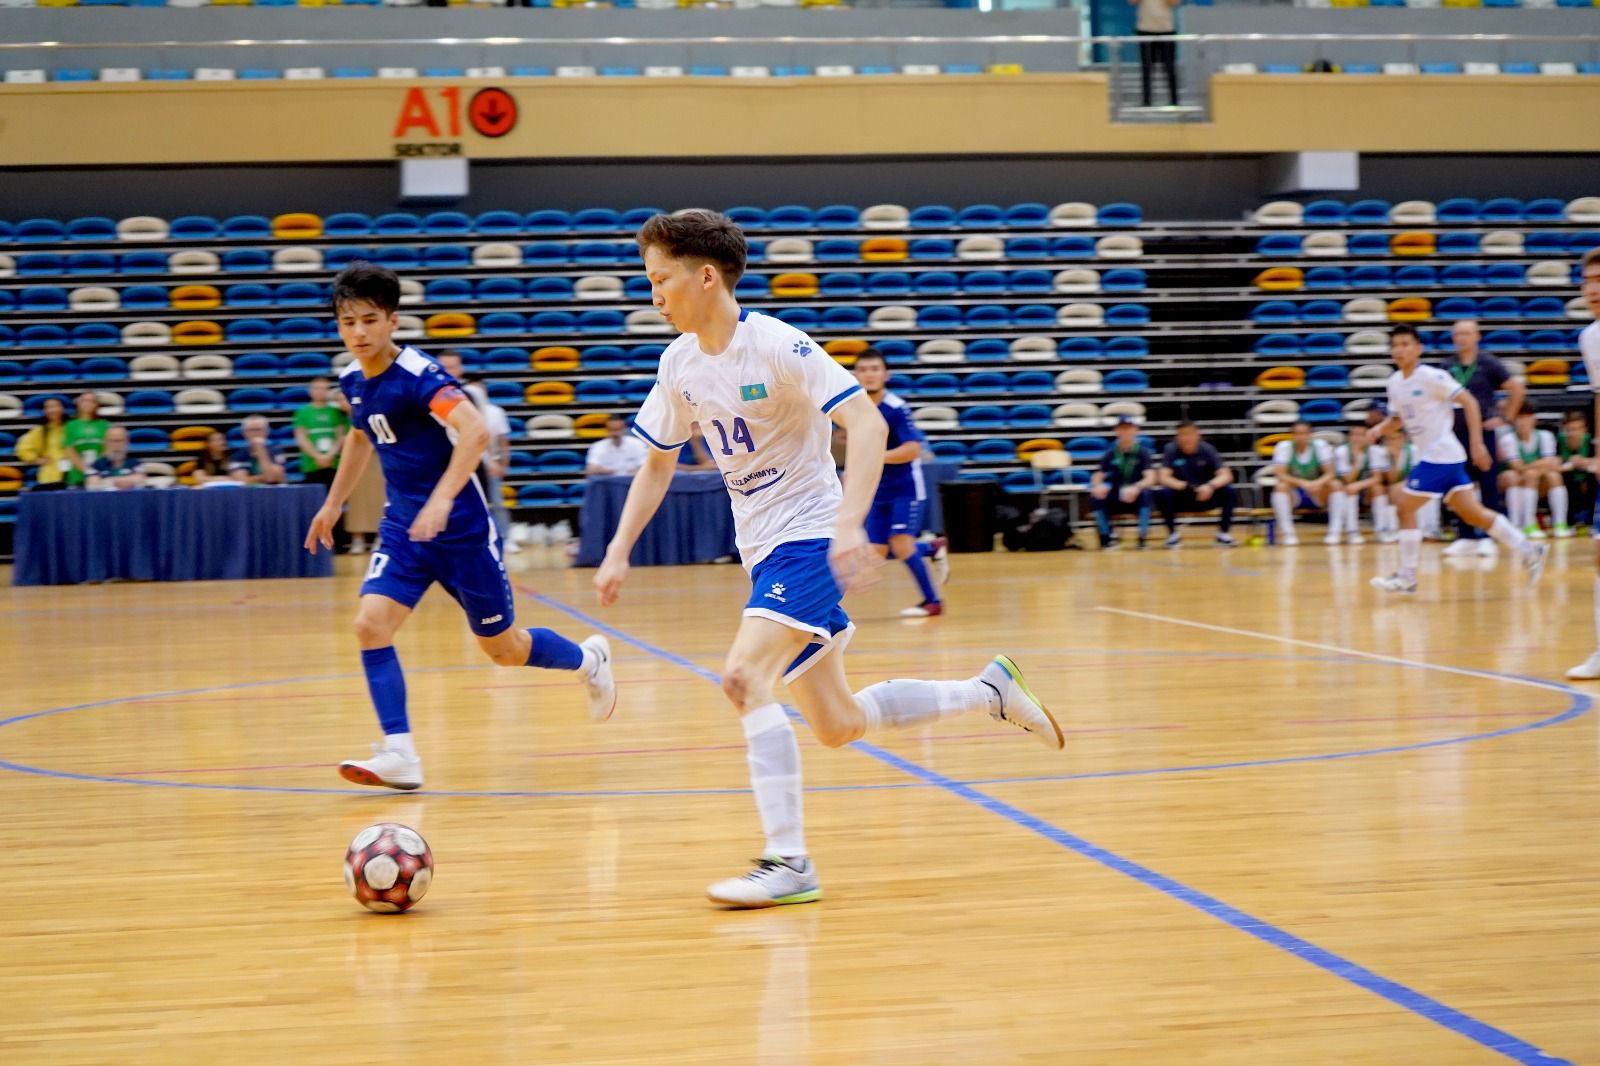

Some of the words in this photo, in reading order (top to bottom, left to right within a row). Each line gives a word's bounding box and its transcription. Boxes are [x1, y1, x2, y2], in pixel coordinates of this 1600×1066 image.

[393, 86, 461, 137] A1
[368, 413, 397, 444] 10
[711, 416, 756, 456] 14
